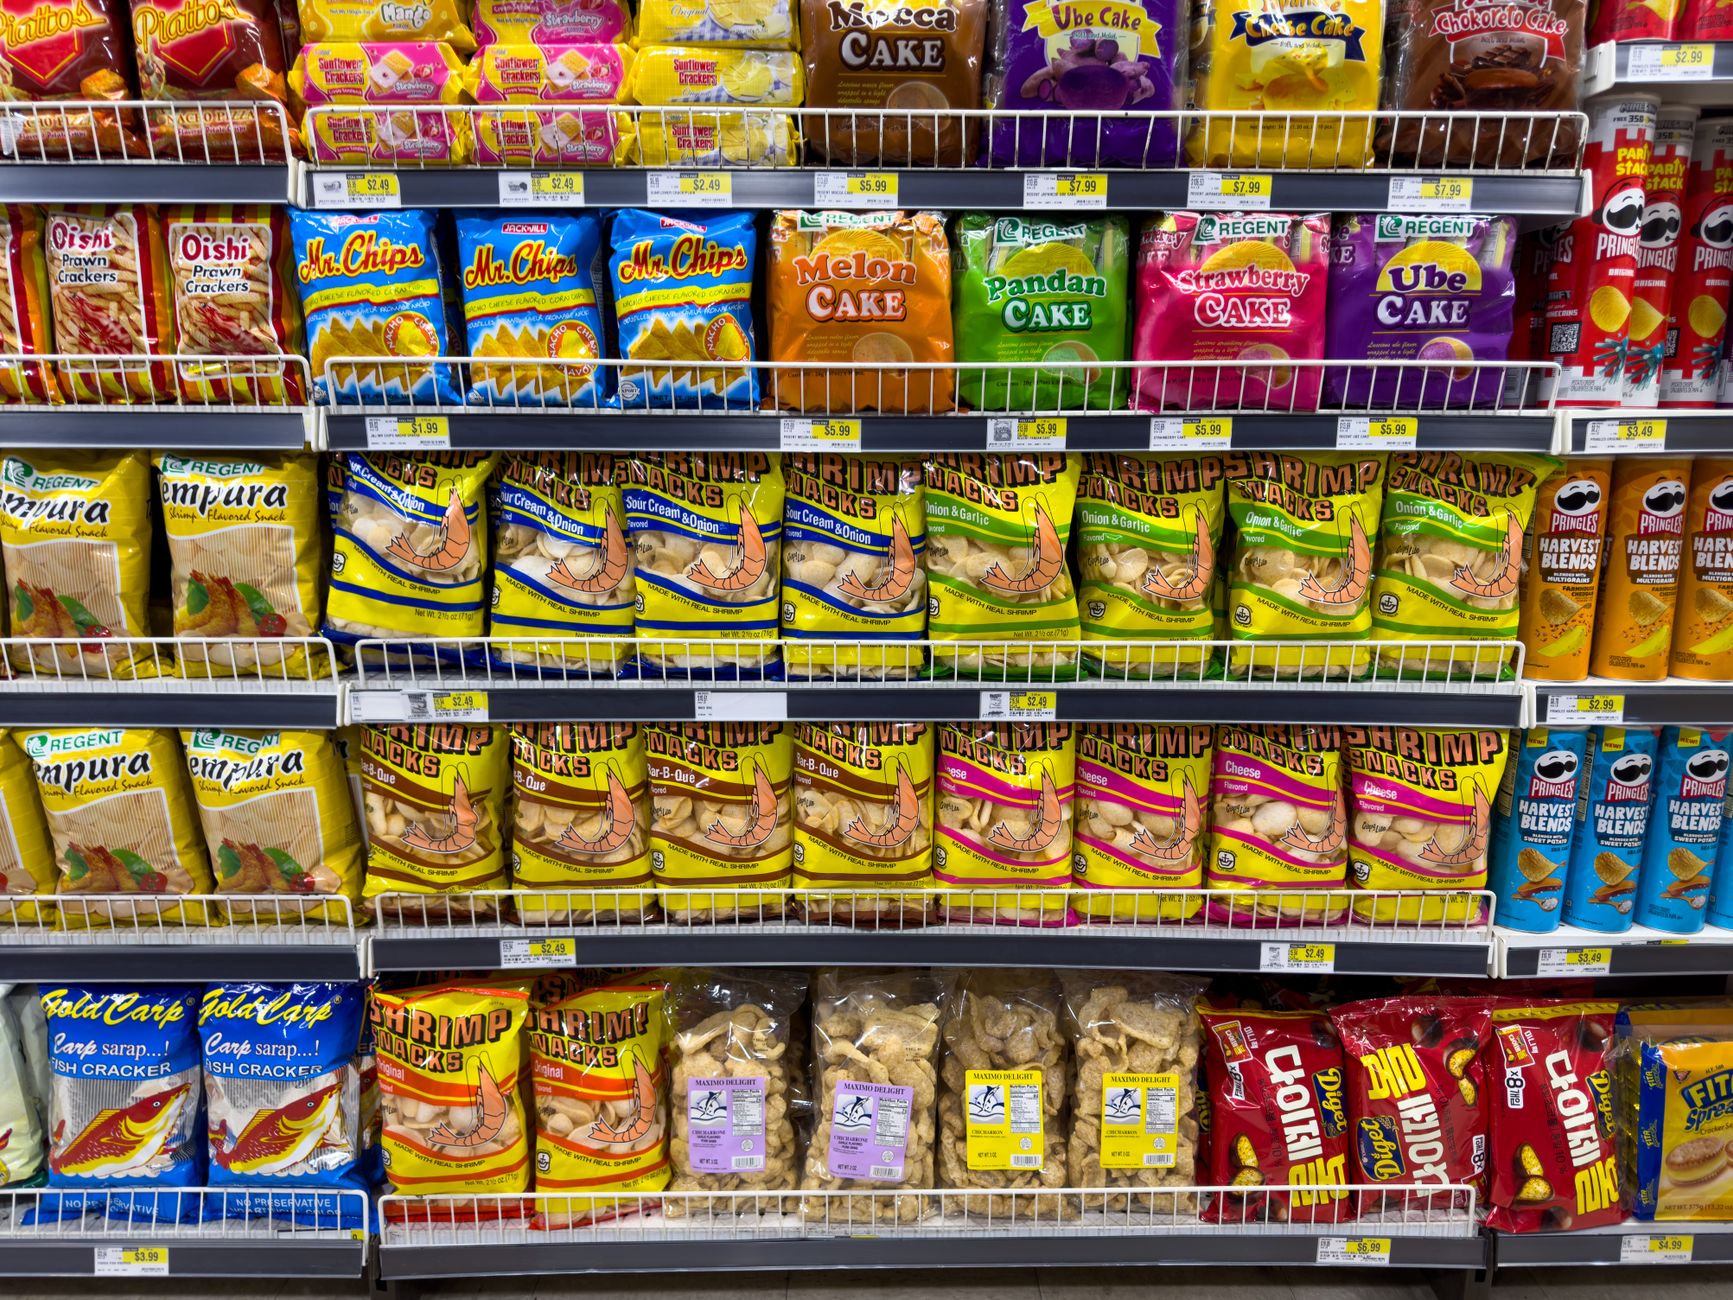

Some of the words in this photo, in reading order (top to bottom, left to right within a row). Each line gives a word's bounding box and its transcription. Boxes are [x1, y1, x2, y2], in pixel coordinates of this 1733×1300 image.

[382, 2, 432, 27] Mango
[671, 4, 708, 17] Original
[1052, 5, 1094, 30] Ube
[1099, 6, 1141, 31] Cake
[134, 0, 254, 53] Piattos
[544, 13, 603, 31] Strawberry
[1311, 15, 1355, 37] Cake
[1434, 4, 1526, 35] Chokoreto
[1525, 10, 1569, 34] Cake
[841, 33, 943, 68] CAKE
[1675, 50, 1702, 63] $2.99
[319, 58, 362, 71] Sunflower
[495, 57, 538, 71] Sunflower
[673, 59, 717, 72] Sunflower
[325, 71, 364, 85] Crackers
[501, 70, 541, 84] Crackers
[679, 72, 717, 86] Crackers
[367, 180, 389, 191] $2.49
[552, 178, 573, 190] $2.49
[693, 179, 720, 191] $2.49
[860, 180, 887, 192] $5.99
[1070, 180, 1097, 194] $7.99
[1233, 181, 1260, 194] $7.99
[1434, 184, 1461, 196] $7.99
[1021, 224, 1086, 239] REGENT
[1219, 220, 1288, 236] REGENT
[1405, 218, 1473, 236] REGENT
[52, 222, 113, 250] Oishi
[181, 234, 249, 260] Oishi
[300, 238, 341, 280] Mr.
[341, 230, 424, 275] Chips
[62, 254, 107, 267] Prawn
[466, 243, 511, 288] Mr.
[512, 240, 577, 282] Chips
[619, 241, 669, 281] Mr.
[671, 234, 748, 277] Chips
[58, 268, 116, 283] Crackers
[193, 265, 241, 278] Prawn
[795, 252, 915, 286] Melon
[985, 269, 1106, 301] Pandan
[1177, 264, 1310, 298] Strawberry
[1388, 264, 1467, 292] Ube
[185, 280, 249, 293] Crackers
[807, 286, 904, 320] CAKE
[1194, 294, 1291, 327] CAKE
[1377, 295, 1468, 324] CAKE
[1005, 299, 1092, 330] CAKE
[388, 316, 404, 349] NACHO
[708, 318, 726, 352] NACHO
[550, 325, 567, 358] NACHO
[411, 422, 438, 434] $1.99
[824, 425, 850, 437] $5.99
[1036, 423, 1057, 434] $5.99
[1195, 424, 1221, 436] $5.99
[1380, 423, 1406, 435] $5.99
[1627, 425, 1653, 437] $3.49
[190, 461, 266, 476] REGENT
[33, 476, 100, 490] REGENT
[169, 507, 197, 520] Shrimp
[207, 508, 252, 522] Flavored
[255, 510, 286, 521] Snack
[627, 496, 647, 511] Sour
[648, 499, 681, 519] Cream
[1395, 501, 1426, 516] Onion
[802, 509, 834, 529] Cream
[1082, 510, 1109, 525] Onion
[1245, 511, 1272, 527] Onion
[1551, 514, 1598, 533] PRINGLES
[1640, 515, 1683, 535] PRINGLES
[76, 523, 108, 537] Snack
[1540, 536, 1601, 554] HARVEST
[1541, 552, 1597, 570] BLENDS
[1630, 554, 1680, 571] BLENDS
[1547, 576, 1590, 584] MULTIGRAINS
[648, 583, 669, 598] MADE
[669, 595, 690, 609] WITH
[690, 604, 711, 615] REAL
[713, 607, 743, 615] SHRIMP
[452, 696, 473, 707] $2.49
[1027, 696, 1047, 707] $2.49
[1589, 700, 1614, 710] $2.99
[50, 731, 122, 751] REGENT
[1079, 767, 1107, 786] Cheese
[1225, 760, 1261, 779] Cheese
[74, 782, 118, 797] Flavored
[121, 775, 153, 791] Snack
[1224, 781, 1248, 791] Flavored
[1364, 781, 1398, 800] Cheese
[1531, 779, 1574, 798] PRINGLES
[1608, 783, 1649, 801] PRINGLES
[1683, 779, 1726, 798] PRINGLES
[1519, 800, 1576, 816] HARVEST
[1595, 804, 1649, 820] HARVEST
[1669, 800, 1725, 816] HARVEST
[1520, 814, 1572, 832] BLENDS
[1597, 820, 1646, 835] BLENDS
[1671, 815, 1721, 831] BLENDS
[1241, 842, 1264, 857] MADE
[1263, 854, 1284, 868] WITH
[1284, 864, 1303, 874] REAL
[541, 943, 565, 954] $2.49
[1305, 948, 1325, 959] $2.49
[1578, 952, 1602, 963] $3.49
[103, 992, 185, 1029] Carp
[370, 998, 512, 1049] SHRIMP
[53, 1033, 98, 1057] Carp
[205, 1033, 252, 1056] Carp
[82, 1061, 171, 1077] CRACKER
[238, 1061, 323, 1078] CRACKER
[973, 1072, 1002, 1080] MAXIMO
[1004, 1072, 1033, 1081] DELIGHT
[1140, 1076, 1171, 1084] DELIGHT
[844, 1082, 872, 1093] MAXIMO
[874, 1085, 906, 1095] DELIGHT
[1318, 1067, 1348, 1131] Diget
[1362, 1119, 1402, 1179] Diget
[1357, 1242, 1381, 1253] $6.99
[1658, 1239, 1682, 1250] $4.99
[134, 1251, 159, 1262] $3.99
